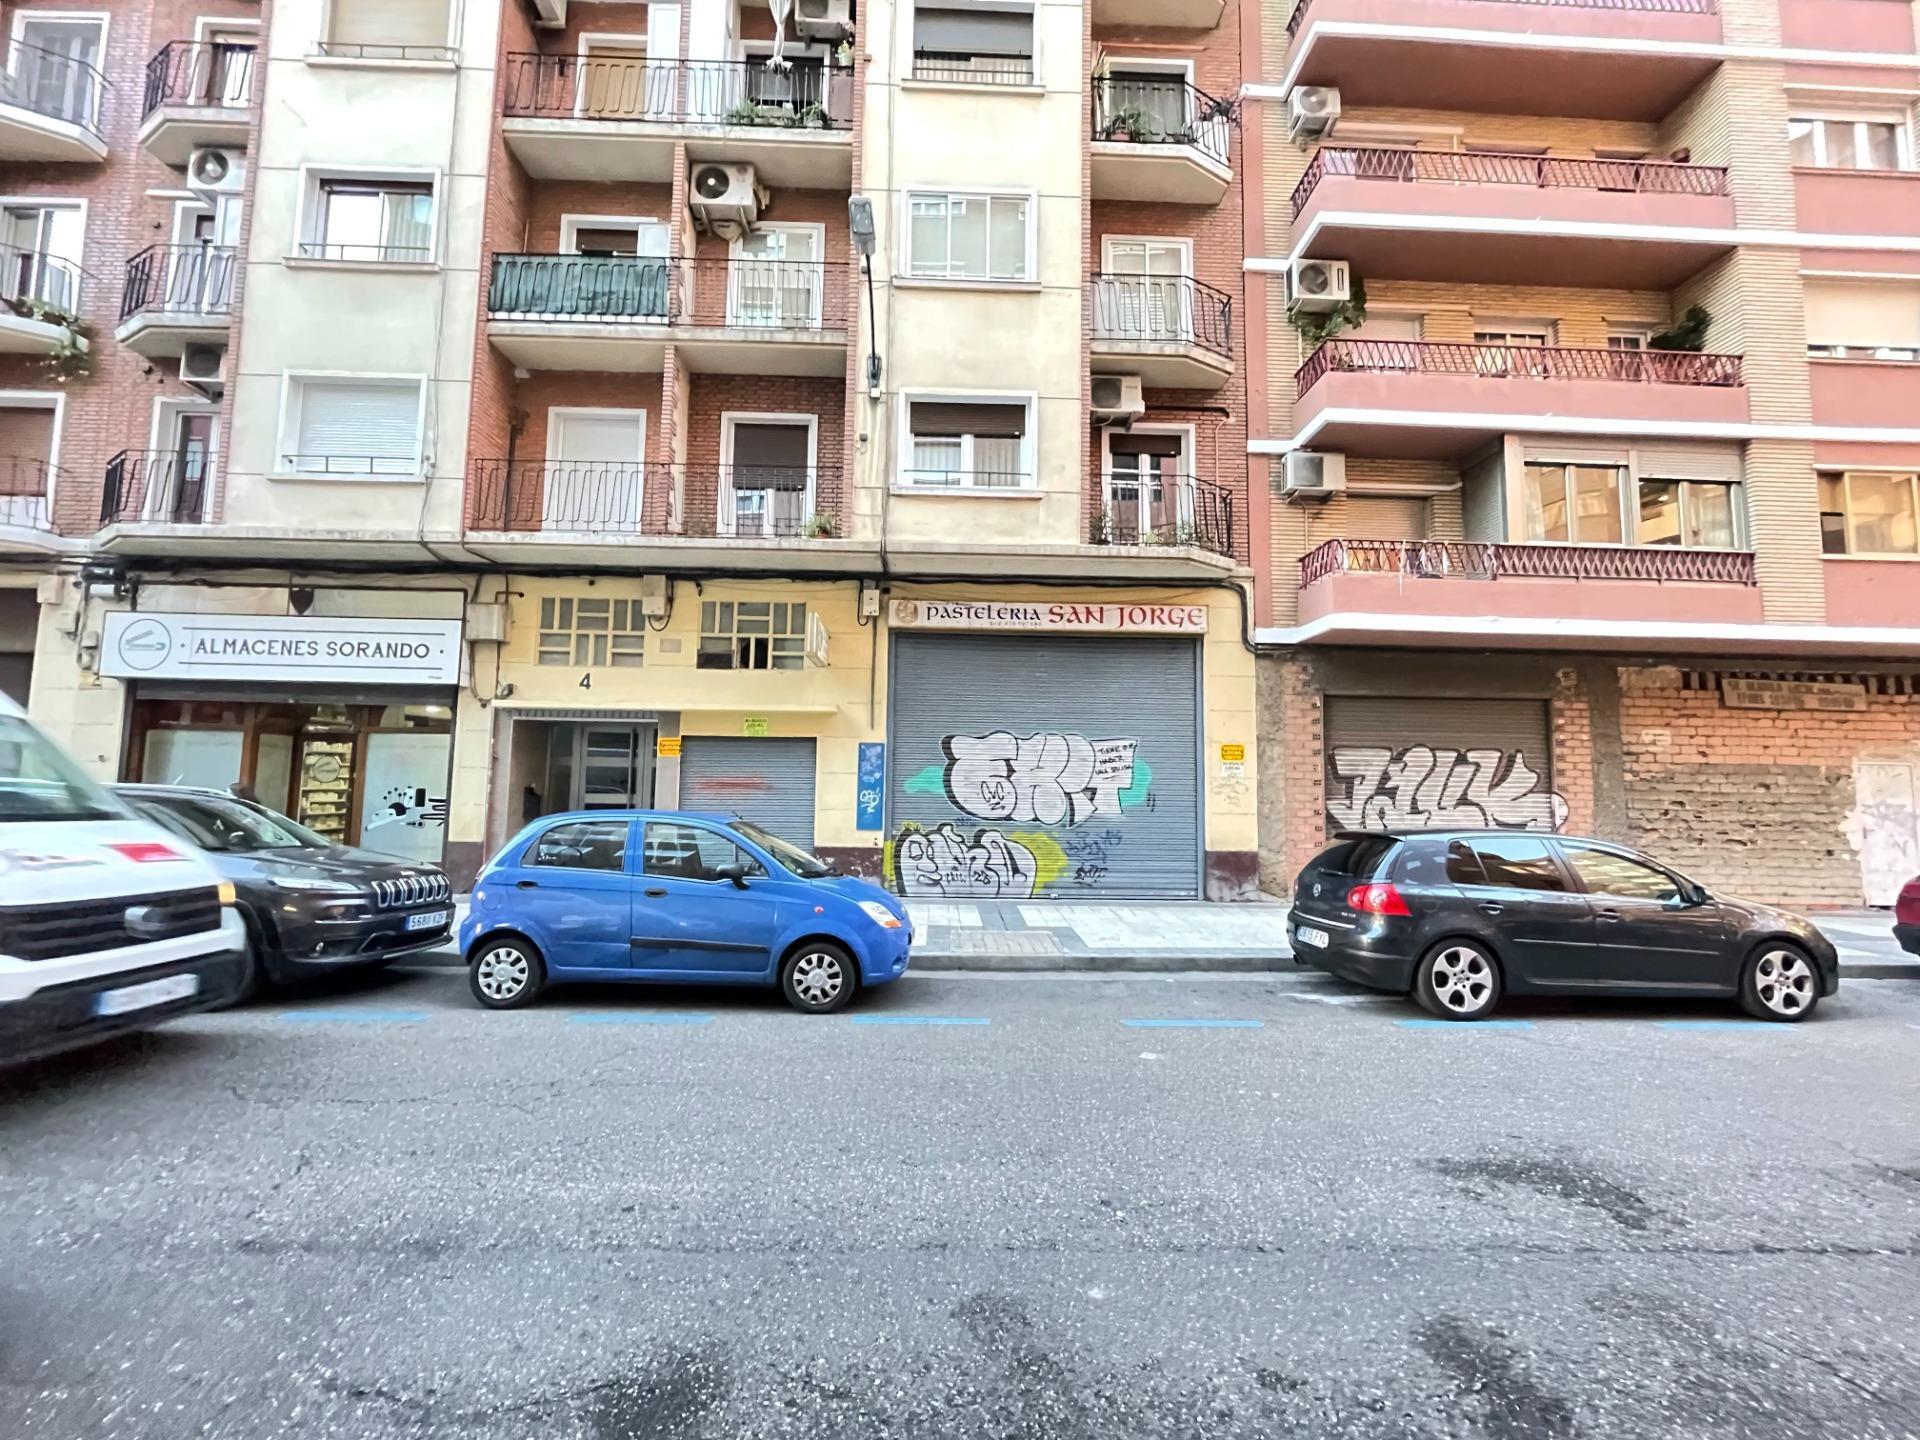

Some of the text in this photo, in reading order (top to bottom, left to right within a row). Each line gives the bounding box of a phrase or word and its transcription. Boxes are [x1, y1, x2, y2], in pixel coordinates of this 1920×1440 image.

[926, 604, 1203, 629] PASTELERIA SAN JORGE
[194, 637, 430, 659] ALMACENES SORANDO
[579, 672, 591, 690] 4
